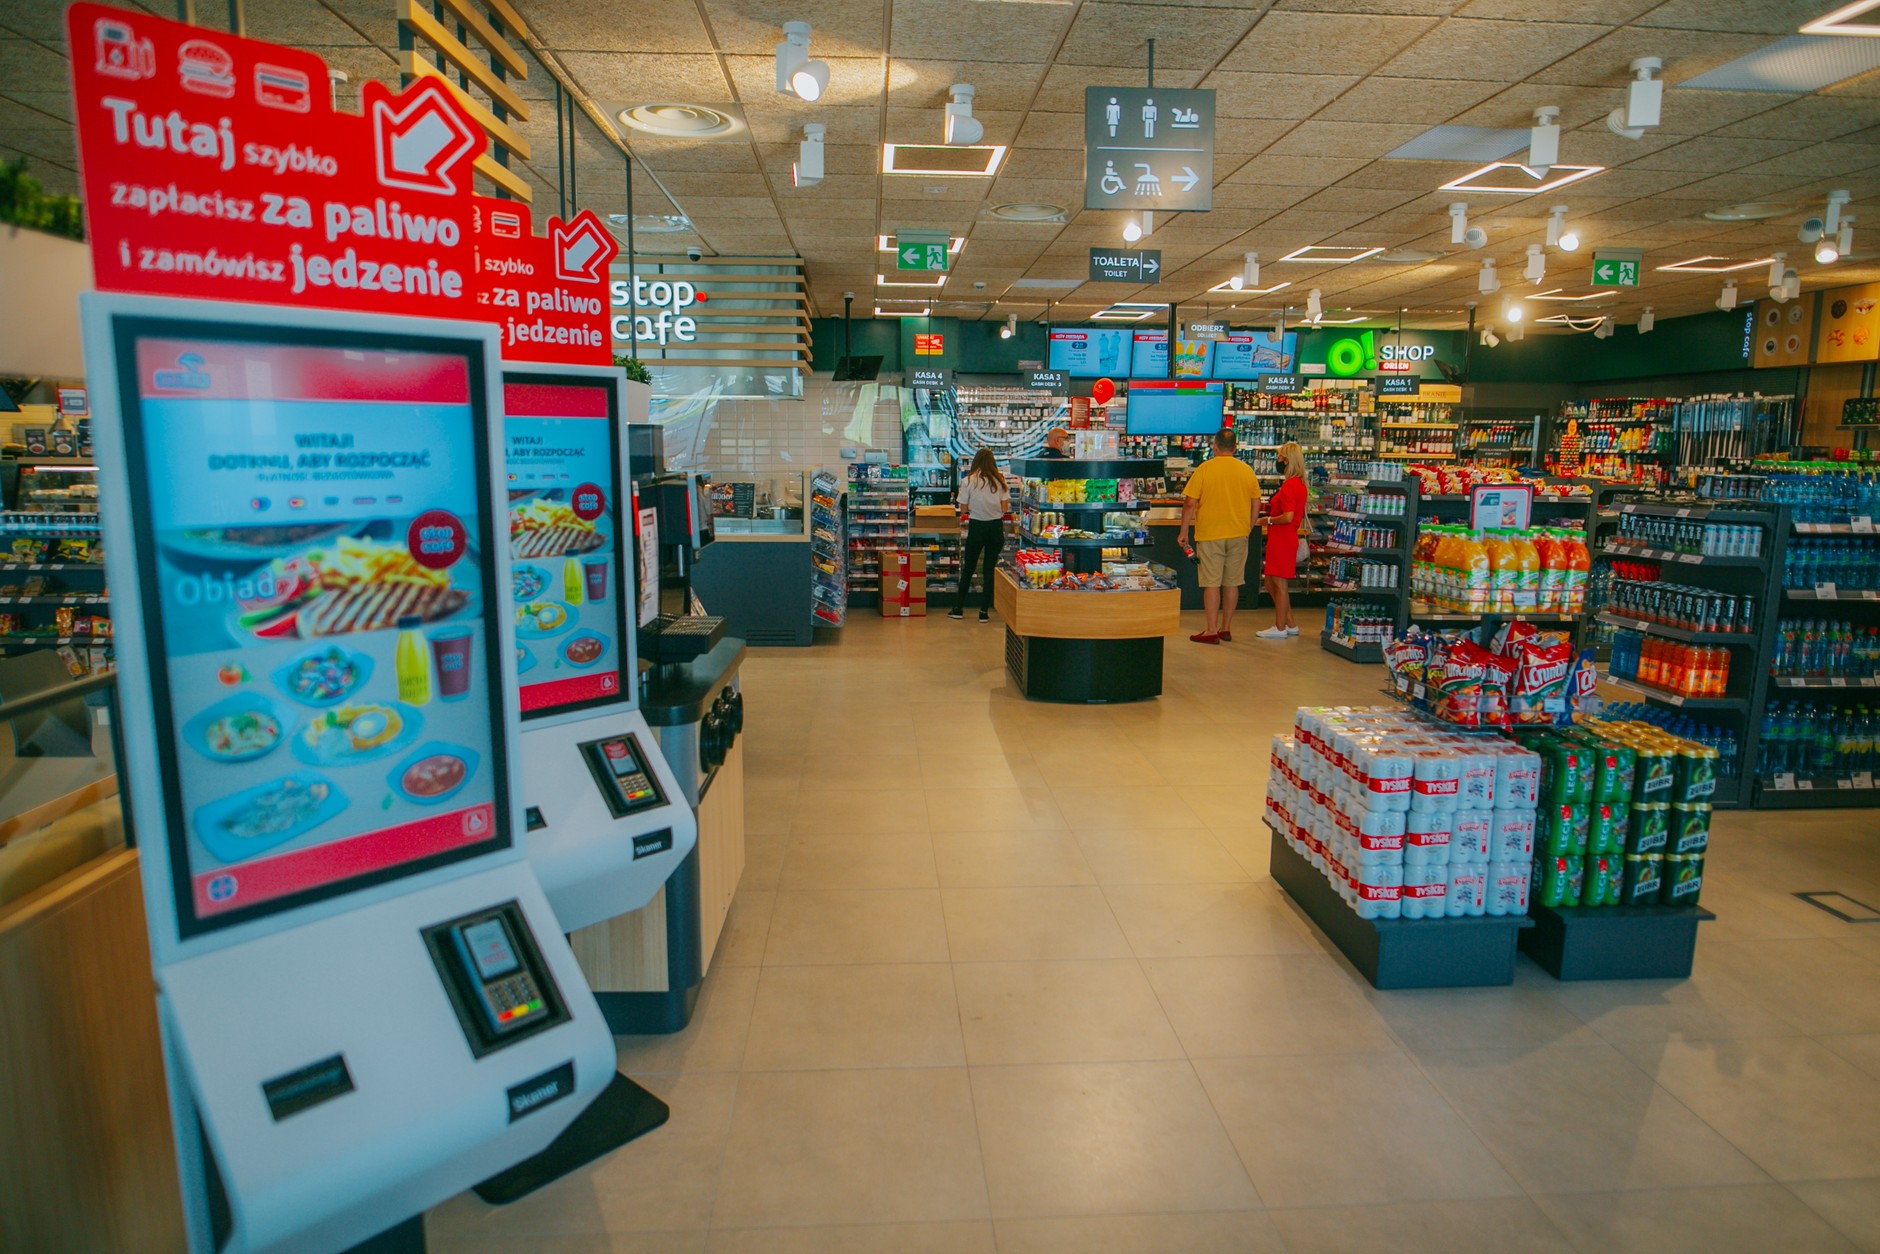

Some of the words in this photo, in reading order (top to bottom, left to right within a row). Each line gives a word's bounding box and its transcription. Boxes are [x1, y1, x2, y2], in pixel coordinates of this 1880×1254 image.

[102, 98, 235, 171] Tutaj
[243, 141, 338, 177] szybko
[111, 182, 254, 223] zapłacisz
[262, 194, 313, 229] za
[325, 199, 460, 248] paliwo
[119, 241, 131, 268] i
[139, 243, 286, 282] zamówisz
[291, 245, 462, 299] jedzenie
[484, 257, 535, 276] szybko
[1093, 256, 1139, 267] TOALETA
[493, 287, 520, 307] za
[526, 287, 601, 315] paliwo
[610, 275, 695, 315] stop
[507, 316, 603, 347] jedzenie
[610, 310, 697, 346] cafe
[1191, 324, 1224, 332] ODBIERZ
[1744, 312, 1752, 334] stop
[1381, 345, 1434, 360] SHOP
[1742, 336, 1750, 358] cafe
[915, 371, 936, 379] KASA
[1383, 362, 1409, 370] ORLEN
[294, 433, 354, 449] WITAJ!
[512, 436, 544, 445] WITAJ!
[296, 453, 332, 469] ABY
[334, 448, 432, 470] ROZPOCZĄĆ
[513, 448, 530, 457] ABY
[533, 447, 585, 457] ROZPOCZĄĆ
[578, 494, 597, 502] stop
[579, 502, 598, 510] cafe
[174, 566, 276, 605] Obiad
[1380, 779, 1410, 791] TYSKIE
[1427, 781, 1458, 793] TYSKIE
[1567, 766, 1577, 793] LECH
[1605, 767, 1616, 793] LECH
[1420, 833, 1450, 844] TYSKIE
[1560, 817, 1571, 848] LECH
[1598, 818, 1610, 848] LECH
[635, 841, 662, 855] Skaner
[1369, 838, 1402, 849] TYSKIE
[1368, 887, 1400, 899] TYSKIE
[1416, 884, 1446, 896] TYSKIE
[1555, 870, 1566, 899] LECH
[1596, 870, 1607, 900] LECH
[513, 1080, 559, 1112] Skaner
